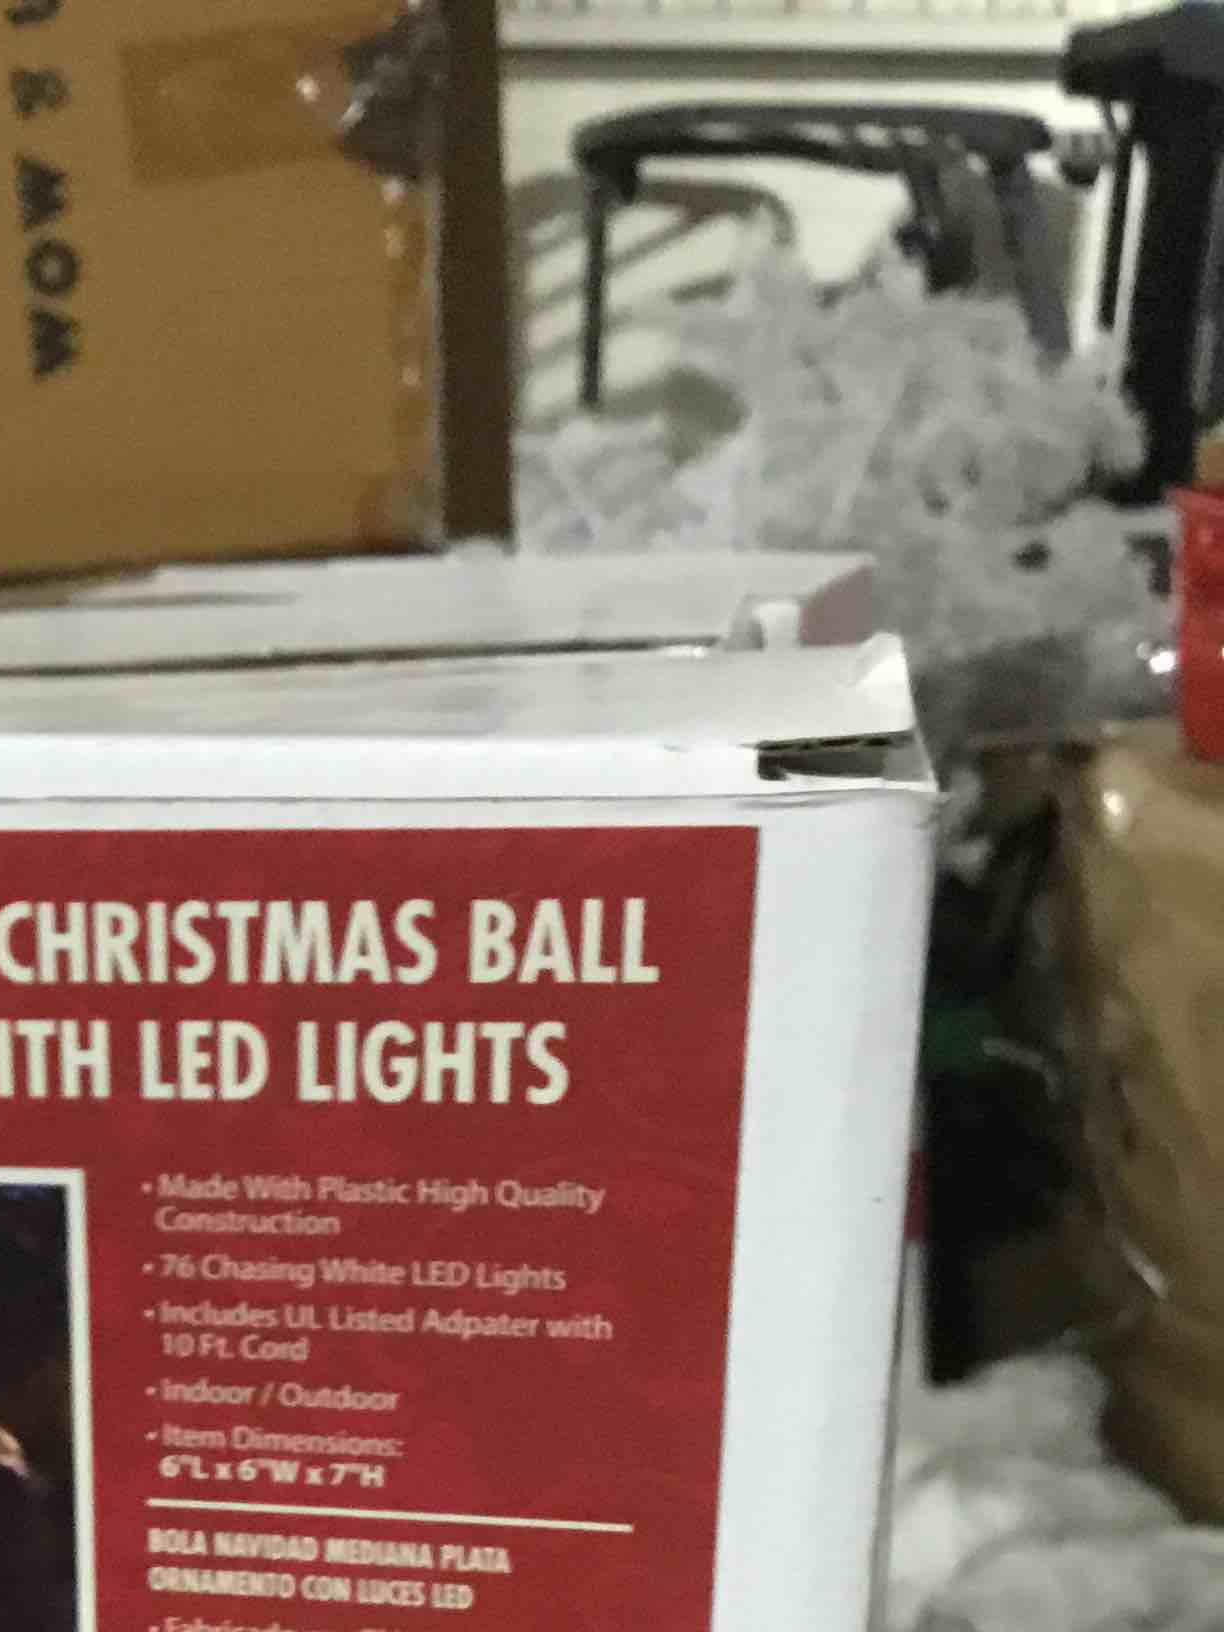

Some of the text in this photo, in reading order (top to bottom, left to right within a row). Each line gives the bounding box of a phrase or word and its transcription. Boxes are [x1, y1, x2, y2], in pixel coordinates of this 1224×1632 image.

[470, 898, 659, 982] BALL
[140, 1018, 269, 1103] LED
[298, 1019, 570, 1107] LIGHTS
[158, 1174, 604, 1214] Made With Plastic High Quality
[155, 1207, 340, 1235] Construction
[160, 1255, 566, 1294] 76 Chasing White LED Lights
[160, 1303, 276, 1327] Includes
[285, 1305, 319, 1330] UL
[329, 1306, 413, 1333] Listed
[547, 1313, 612, 1339] with
[163, 1335, 194, 1356] 10
[241, 1336, 308, 1361] Cord
[163, 1380, 255, 1404] Indoor
[280, 1383, 399, 1411] Outdoor
[163, 1426, 225, 1450] Item
[215, 1463, 231, 1480] x
[306, 1466, 323, 1485] x
[147, 1529, 510, 1573] BOLA NAVIDAD MEDIANA PLATA
[301, 1574, 351, 1601] CON
[357, 1579, 425, 1605] LUCES
[431, 1583, 472, 1609] LED
